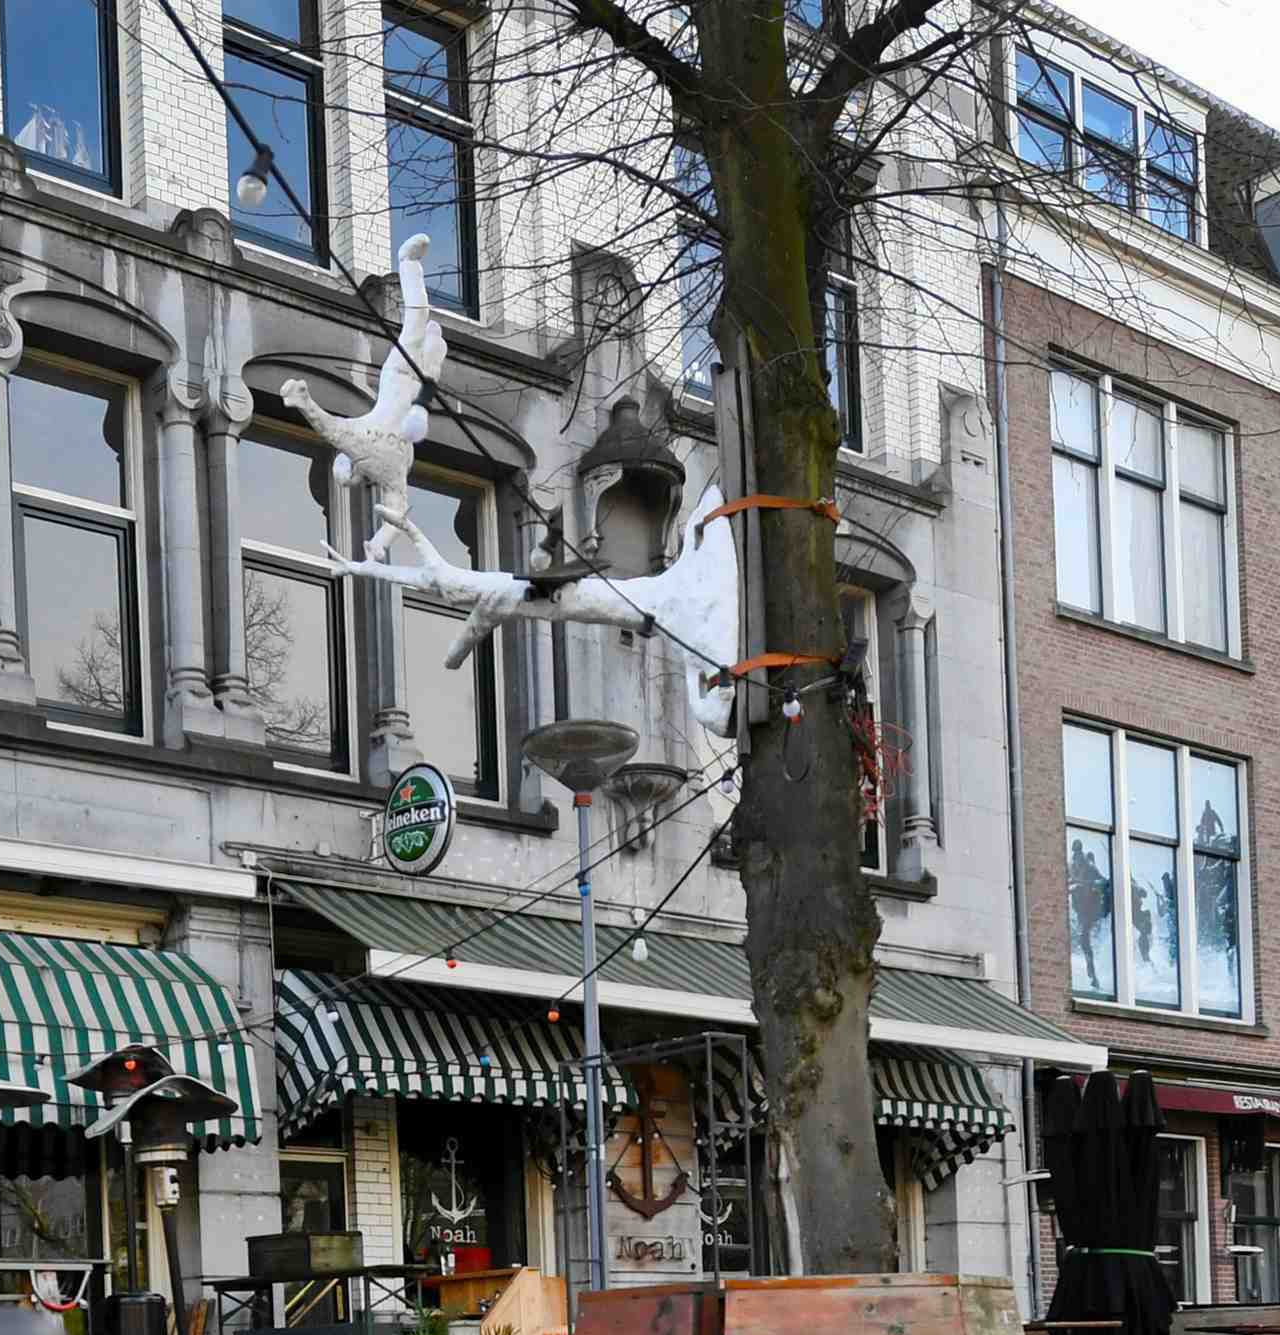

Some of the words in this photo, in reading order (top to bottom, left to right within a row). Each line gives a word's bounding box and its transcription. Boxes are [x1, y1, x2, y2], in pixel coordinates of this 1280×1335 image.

[387, 805, 441, 831] eineken
[430, 1225, 477, 1244] Noah
[703, 1231, 733, 1246] oah
[616, 1235, 686, 1262] Noah
